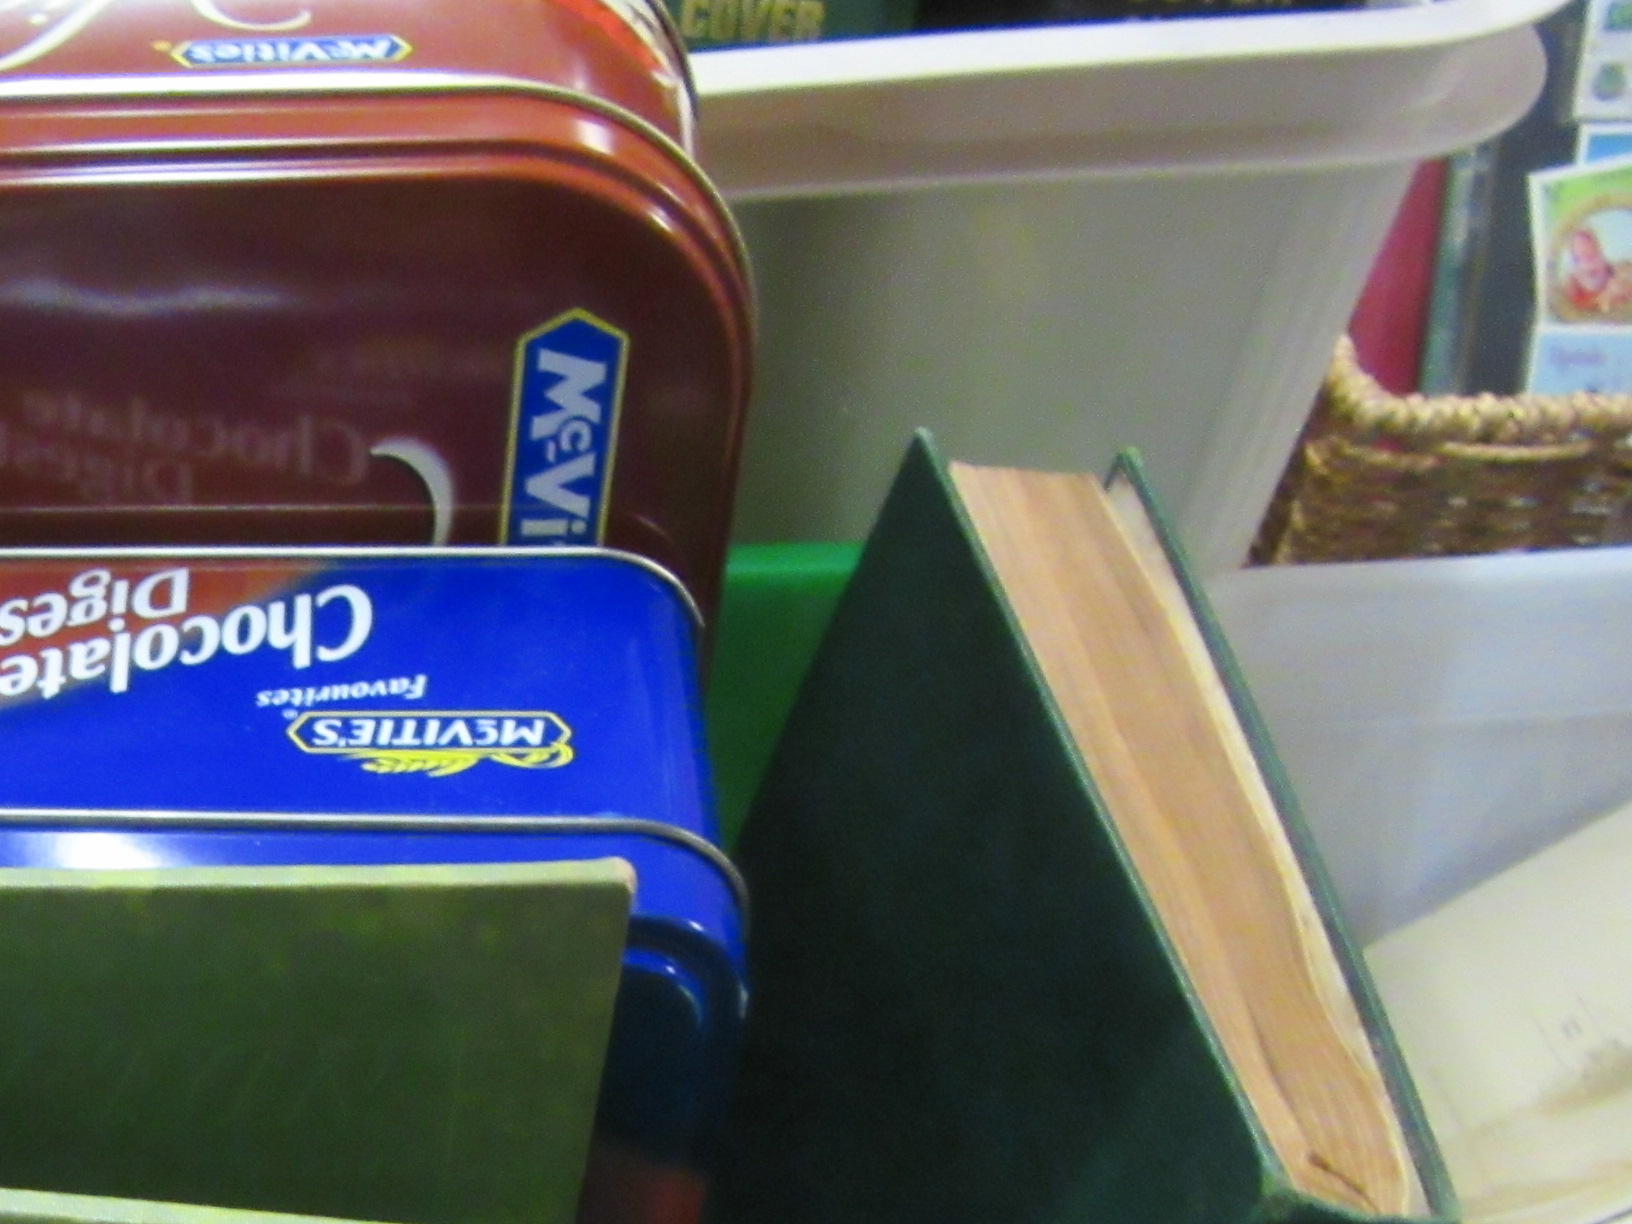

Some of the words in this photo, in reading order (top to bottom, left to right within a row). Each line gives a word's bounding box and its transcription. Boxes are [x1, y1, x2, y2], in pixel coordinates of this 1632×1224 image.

[681, 0, 828, 42] COVER
[520, 347, 609, 545] McVi
[256, 674, 428, 708] Favourites
